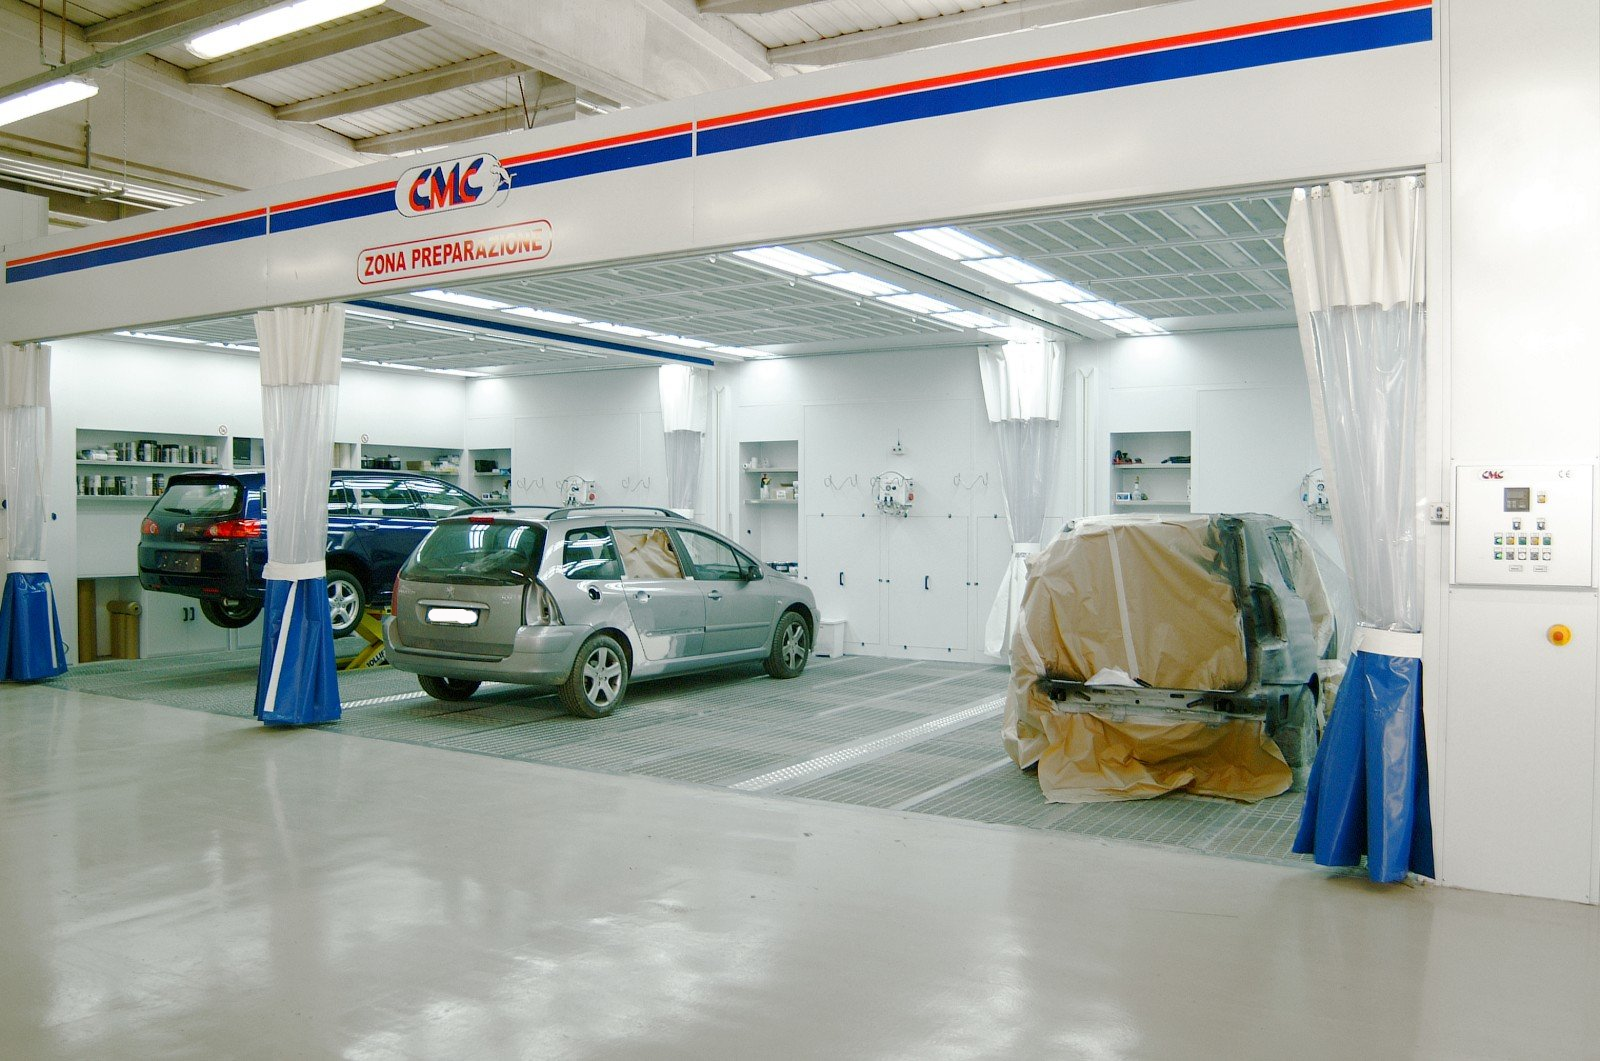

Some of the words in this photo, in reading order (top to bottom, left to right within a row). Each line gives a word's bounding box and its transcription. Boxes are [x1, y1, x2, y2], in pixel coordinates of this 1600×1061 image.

[409, 157, 484, 212] CMC
[364, 251, 407, 276] ZONA
[411, 228, 543, 270] PREPARAZIONE
[1481, 470, 1504, 480] CMC
